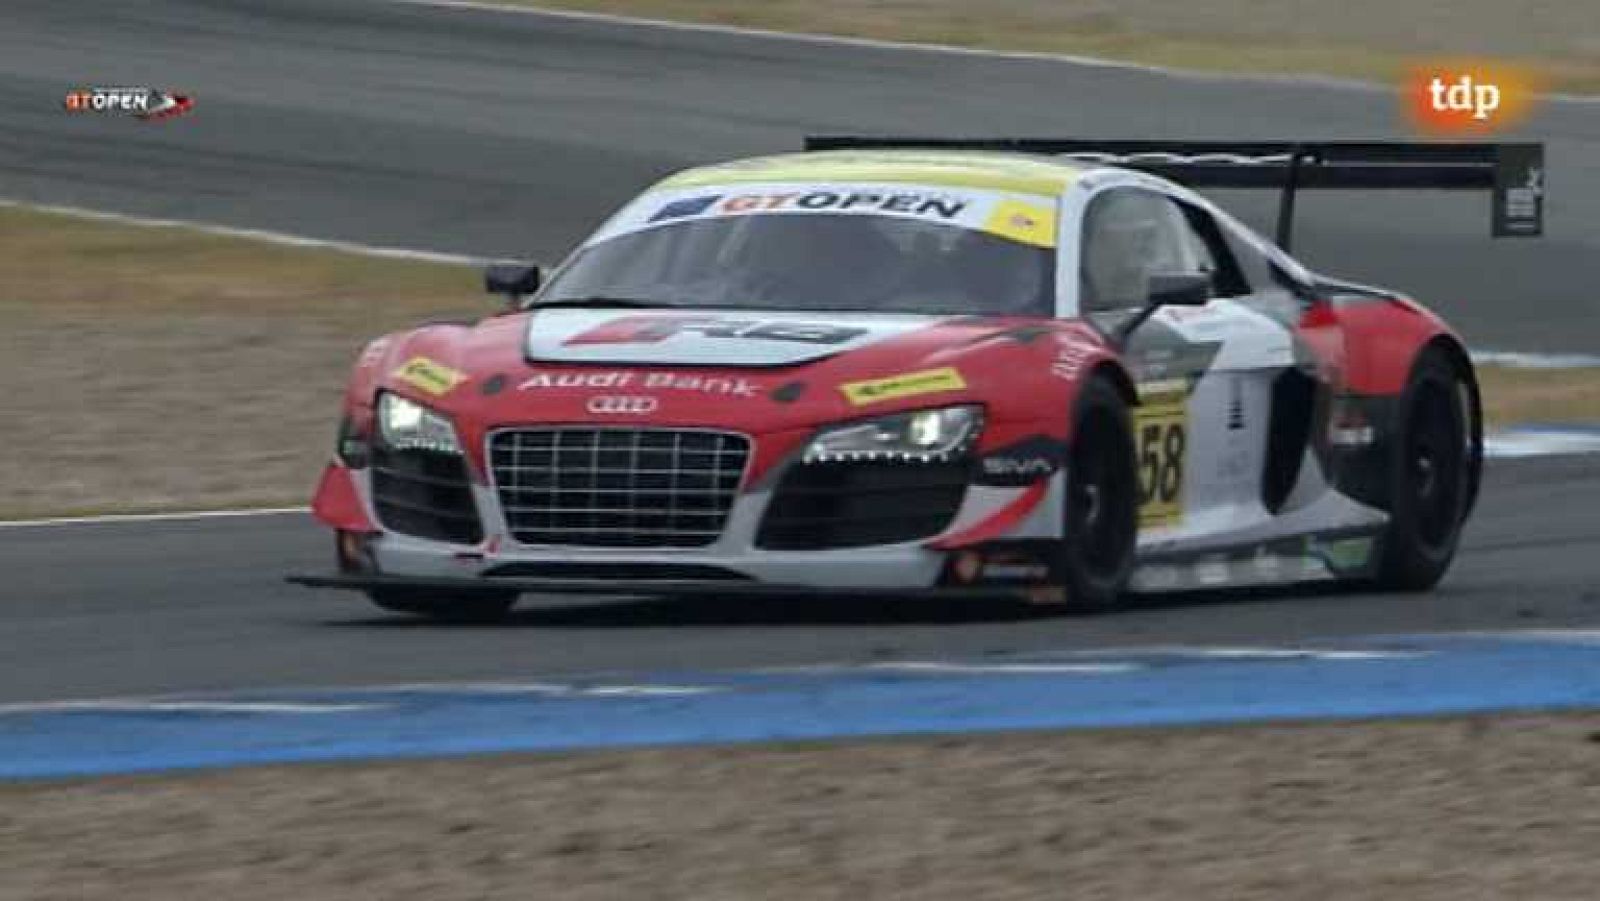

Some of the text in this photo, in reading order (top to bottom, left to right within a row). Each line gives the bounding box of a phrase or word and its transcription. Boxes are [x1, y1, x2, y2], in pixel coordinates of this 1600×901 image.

[517, 372, 761, 396] Audi Bank
[1137, 422, 1184, 502] 58
